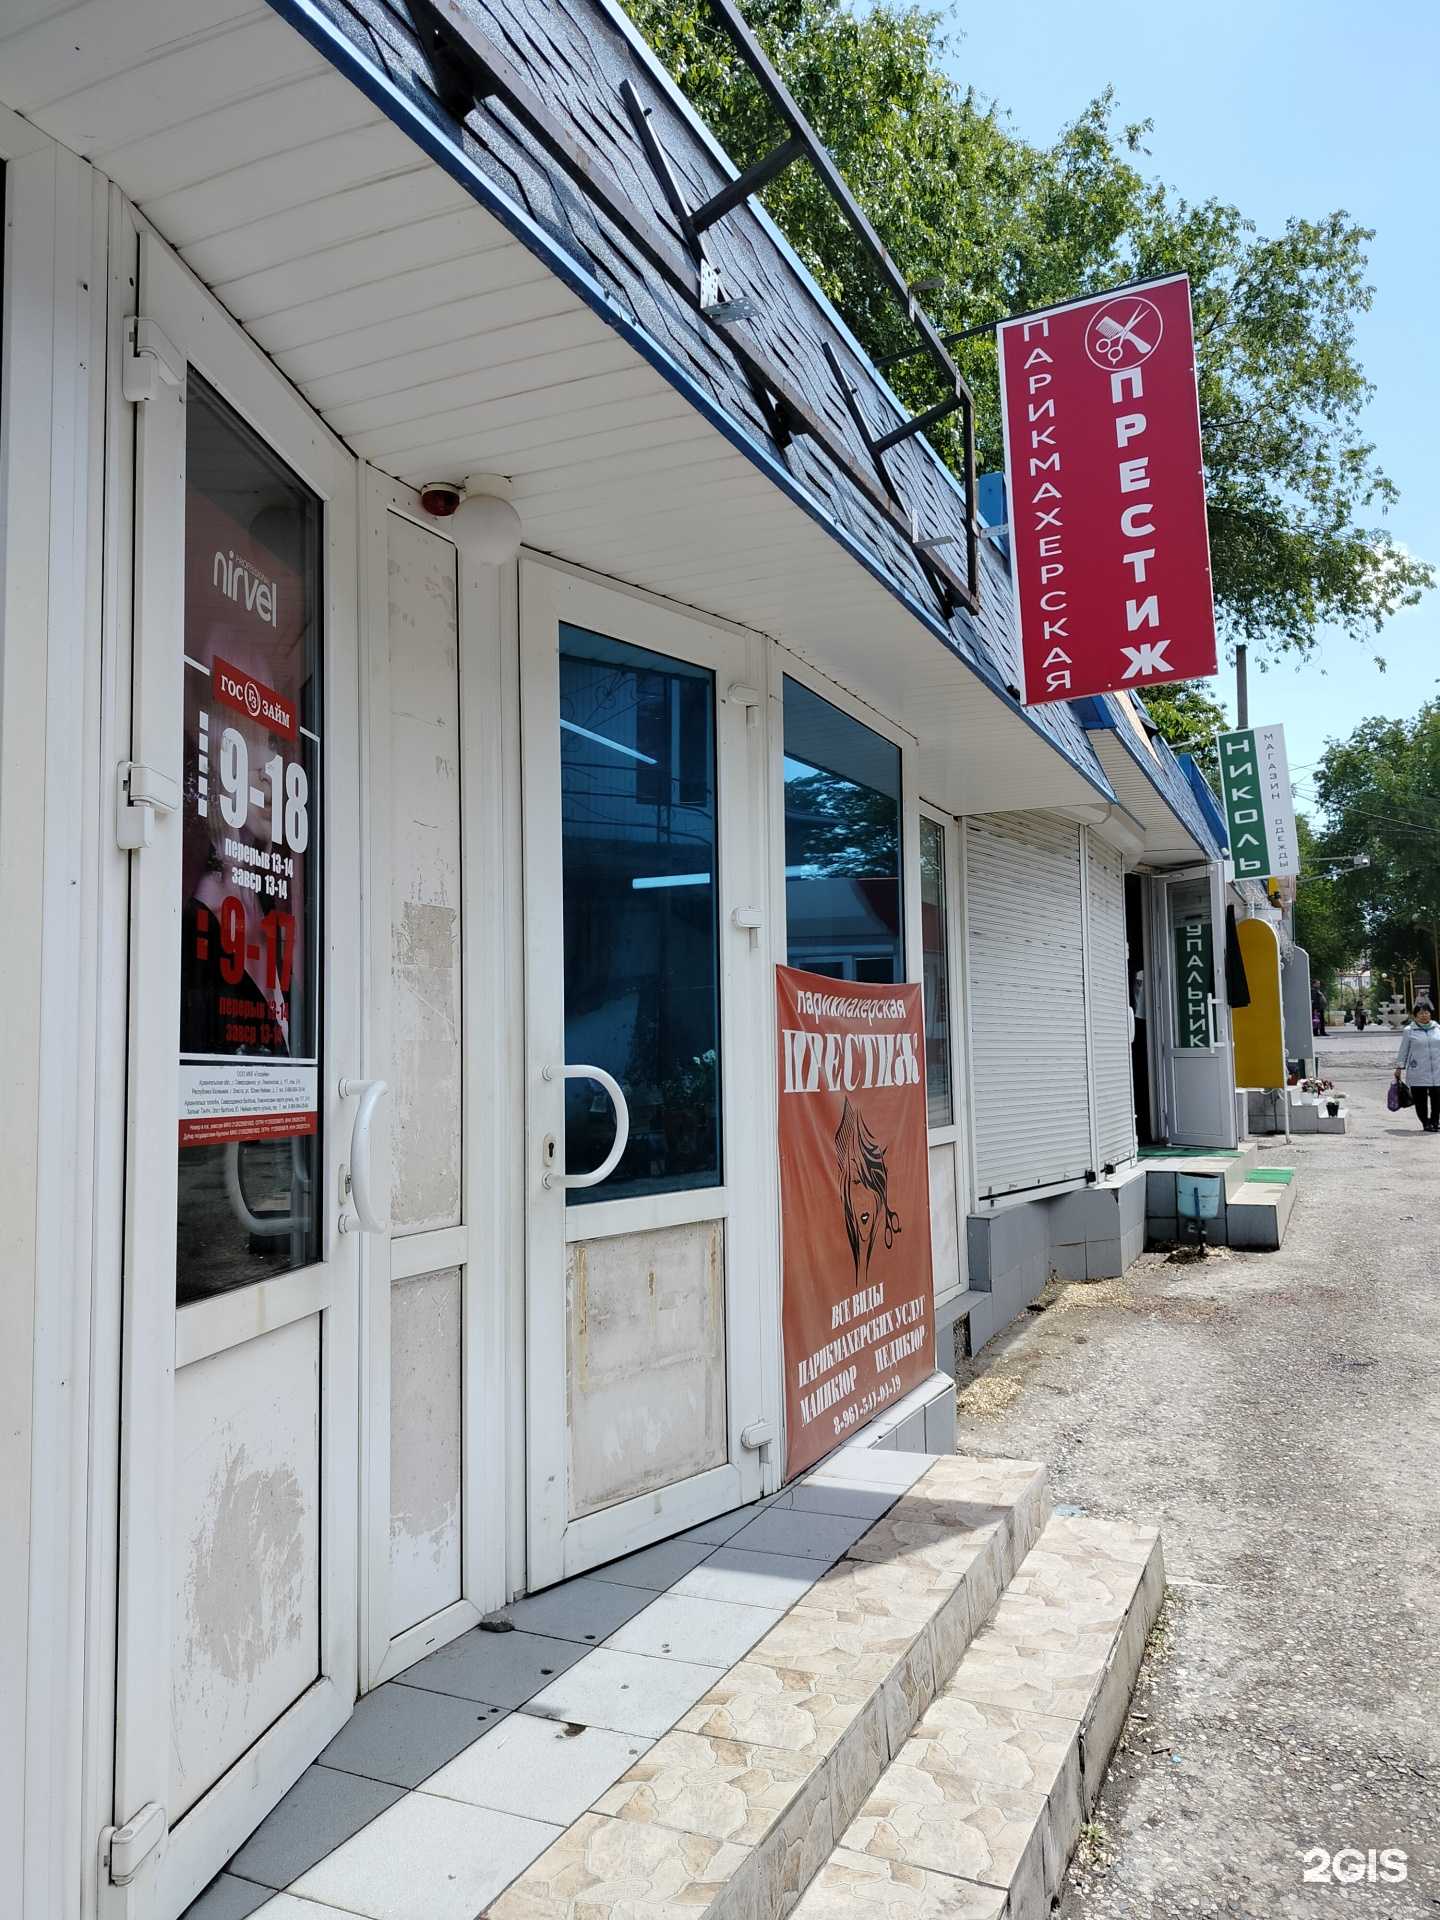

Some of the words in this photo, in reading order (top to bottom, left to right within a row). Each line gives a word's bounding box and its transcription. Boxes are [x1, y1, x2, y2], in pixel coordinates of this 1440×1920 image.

[1023, 319, 1073, 692] ПАРИКМАХЕРСКАЯ
[1110, 367, 1175, 680] ПРЕСТИЖ
[213, 550, 277, 628] nirvel
[262, 699, 290, 729] ЗАЙМ
[219, 726, 309, 854] 9-18
[1226, 739, 1262, 871] НИКОЛЬ
[1263, 733, 1280, 800] МАГАЗИН
[1274, 818, 1288, 868] ОДЕЖДЫ
[225, 838, 270, 870] перерыв
[271, 852, 294, 878] 13-14
[264, 875, 288, 900] 13-14
[219, 895, 296, 993] 9-17
[797, 990, 907, 1027] парикмахерская
[782, 1028, 921, 1093] ПРЕСТИЖ
[798, 1310, 894, 1388] ПАРИКМАХЕРСКИХ
[894, 1294, 926, 1329] УСЛУГ
[831, 1298, 851, 1330] ВСЕ
[852, 1281, 885, 1317] ВИДЫ
[799, 1364, 858, 1426] МАНИКЮР
[874, 1325, 926, 1373] ПЕДИКЮР
